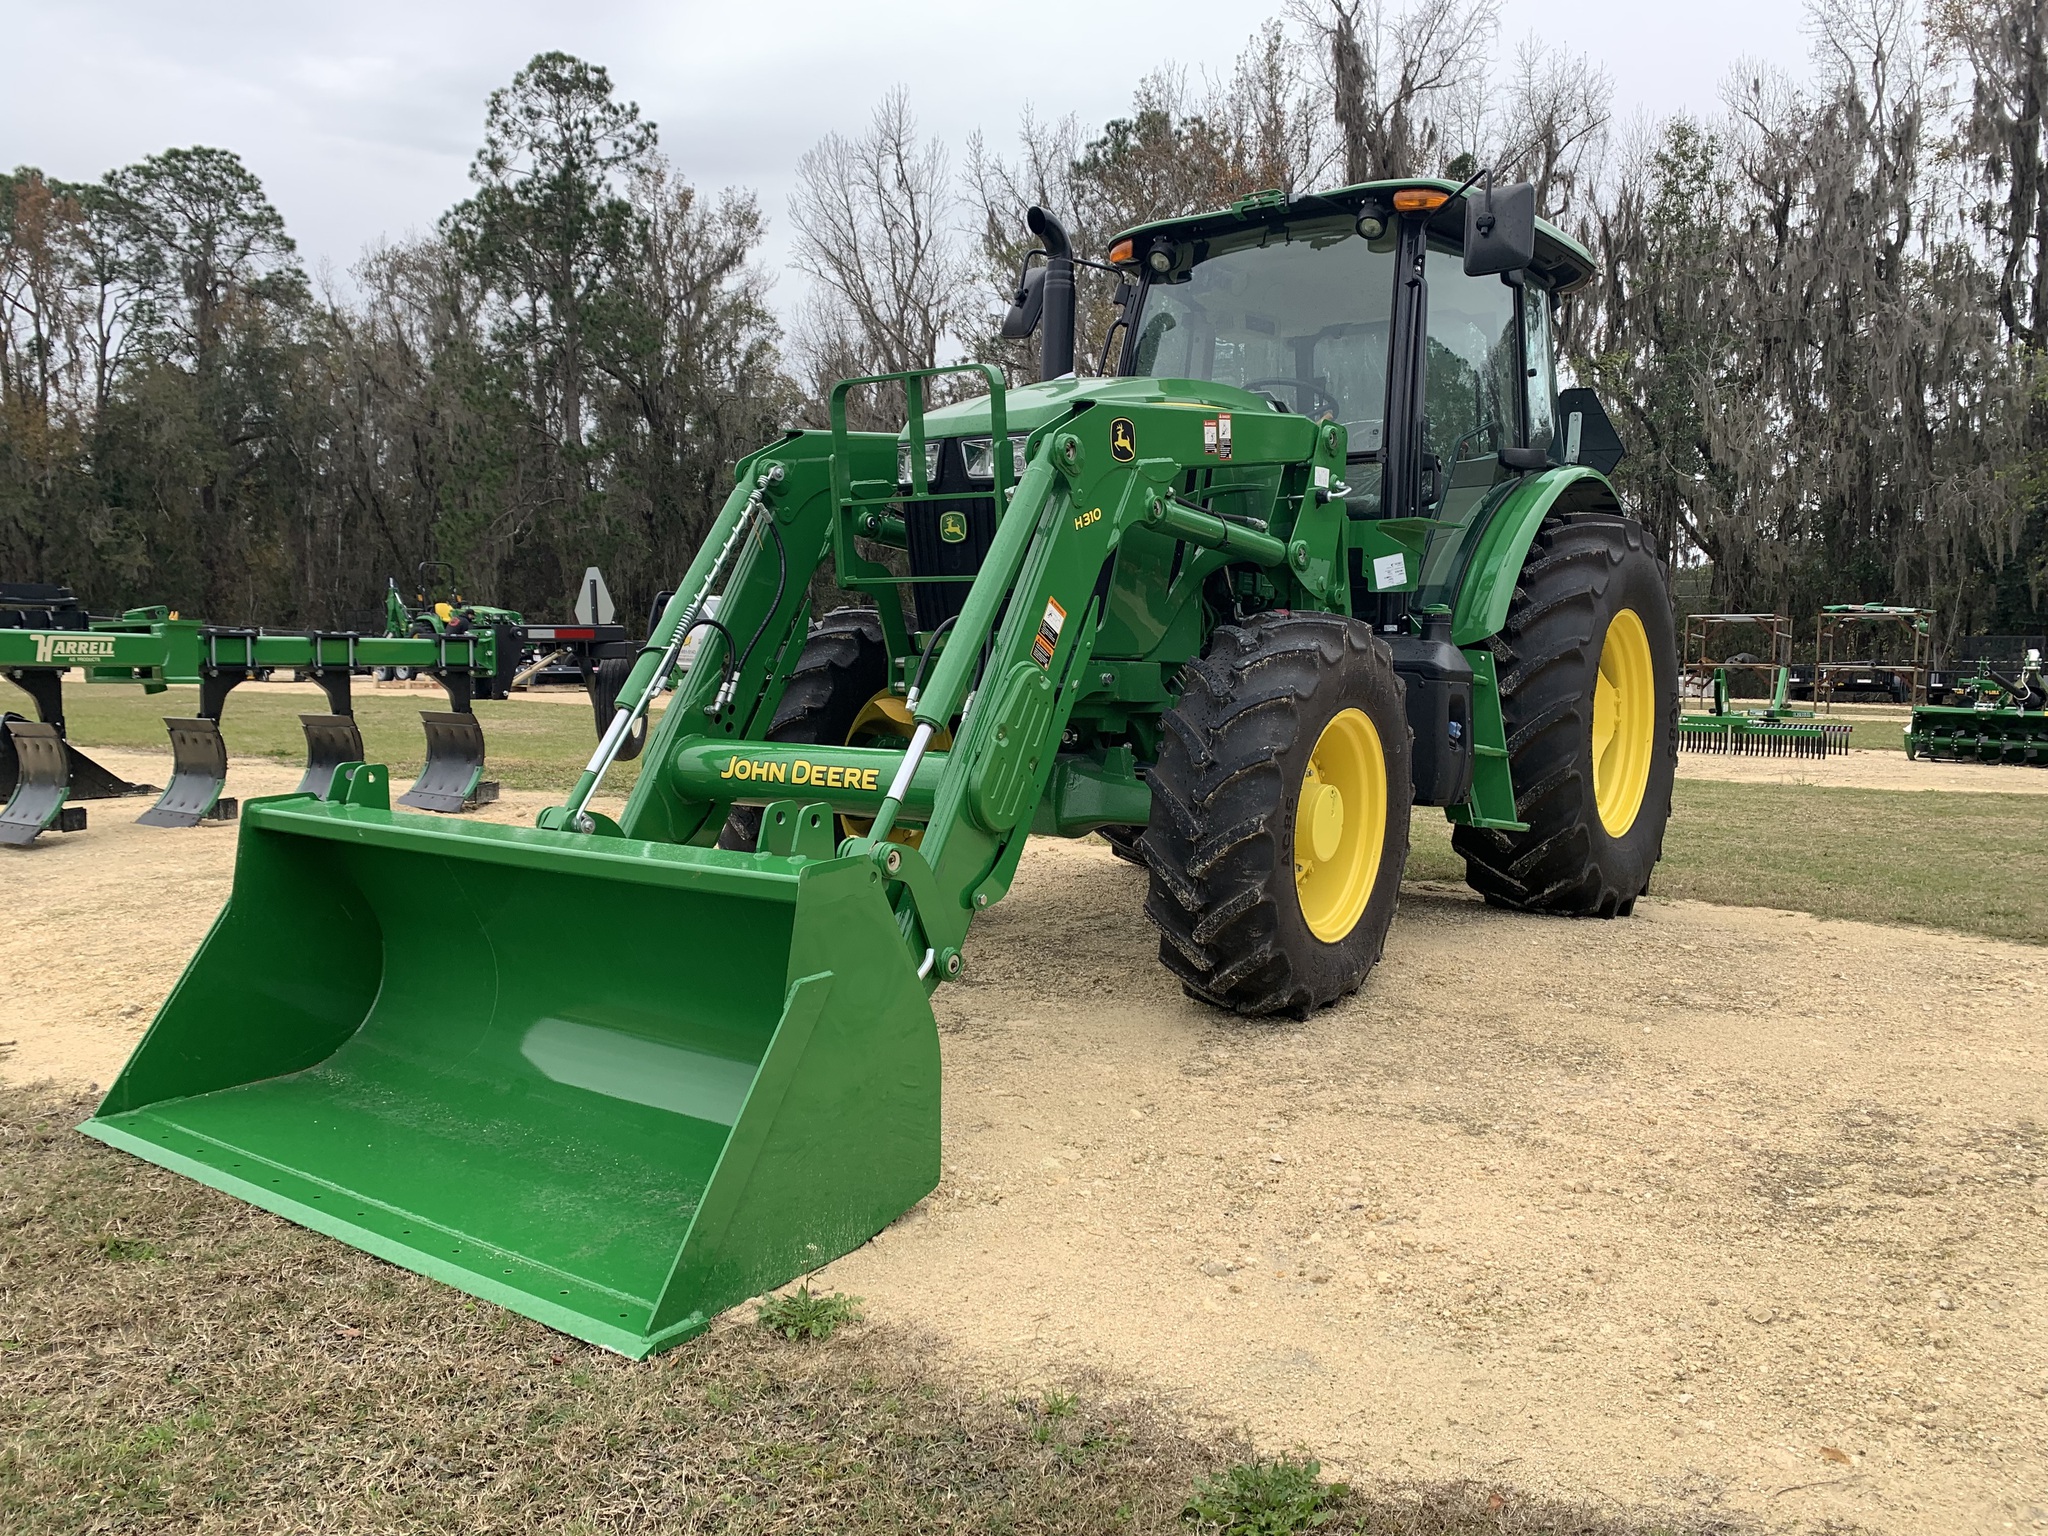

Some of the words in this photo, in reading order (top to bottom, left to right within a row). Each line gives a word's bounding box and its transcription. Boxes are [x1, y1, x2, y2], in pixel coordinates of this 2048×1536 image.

[1074, 507, 1102, 531] H310
[30, 634, 116, 662] HARRELL
[720, 755, 788, 783] JOHN
[791, 759, 880, 790] DEERE
[1281, 796, 1294, 867] AC85
